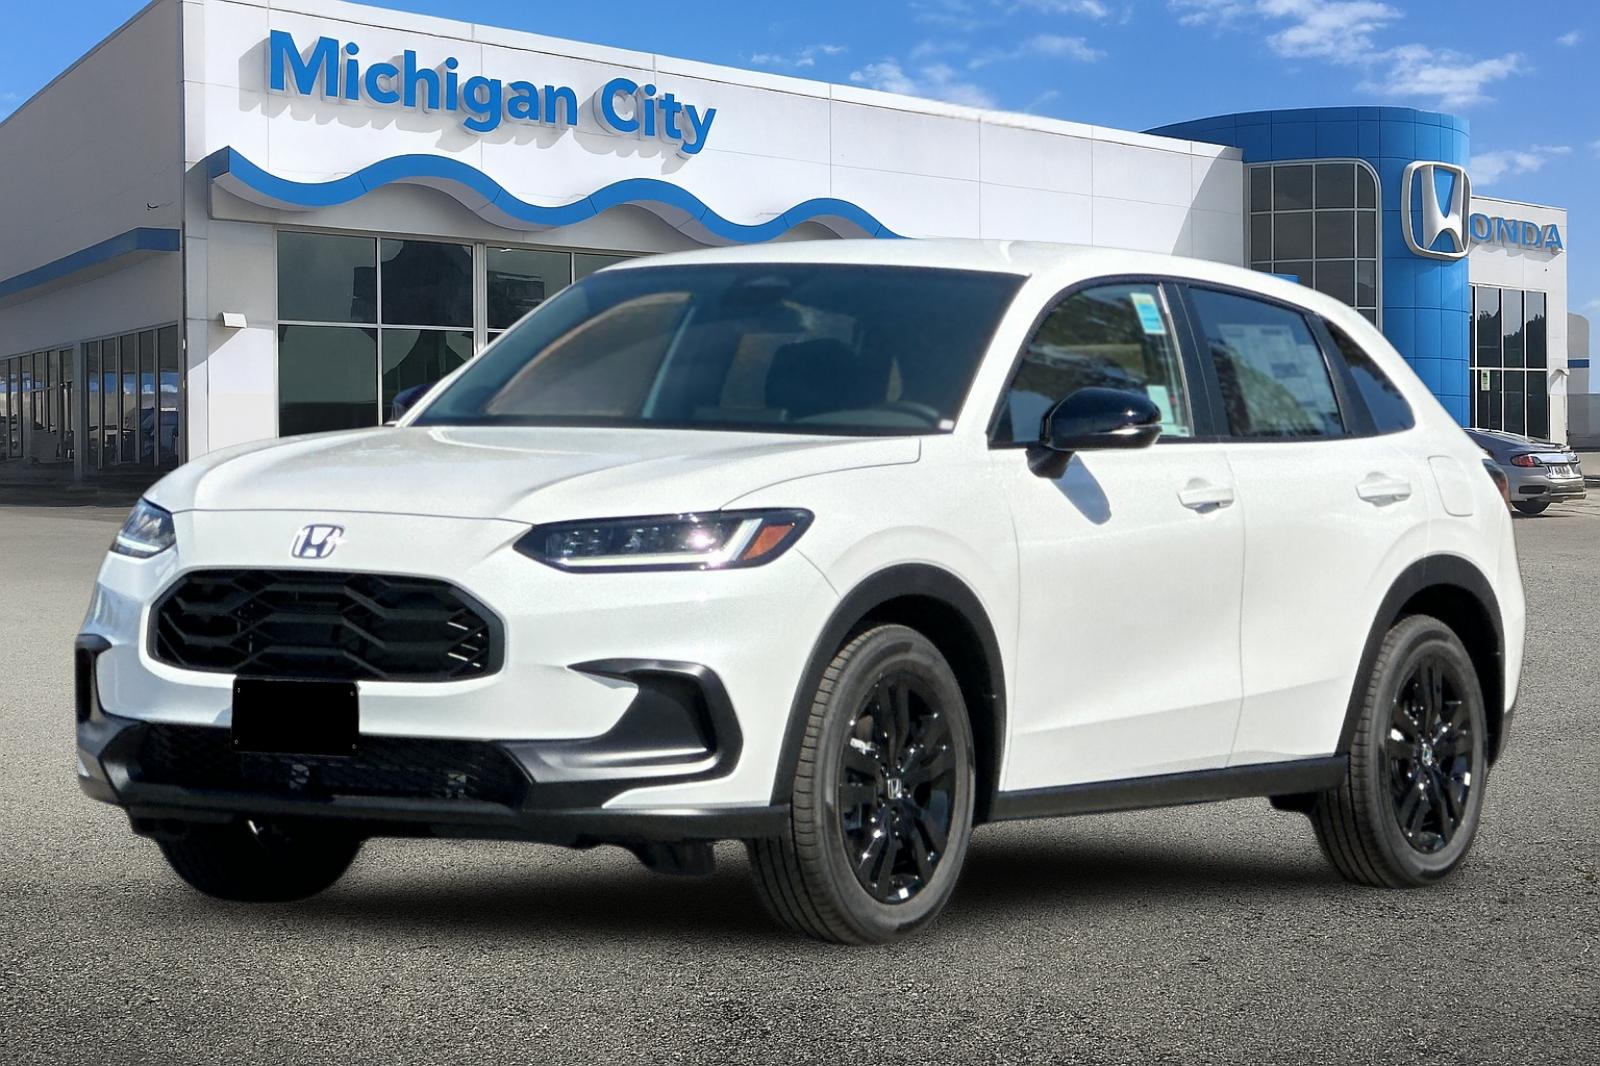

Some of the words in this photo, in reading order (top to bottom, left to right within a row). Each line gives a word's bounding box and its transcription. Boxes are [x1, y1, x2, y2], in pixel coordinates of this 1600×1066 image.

[269, 29, 578, 133] Michigan
[601, 77, 717, 155] City
[1470, 213, 1564, 250] ONDA
